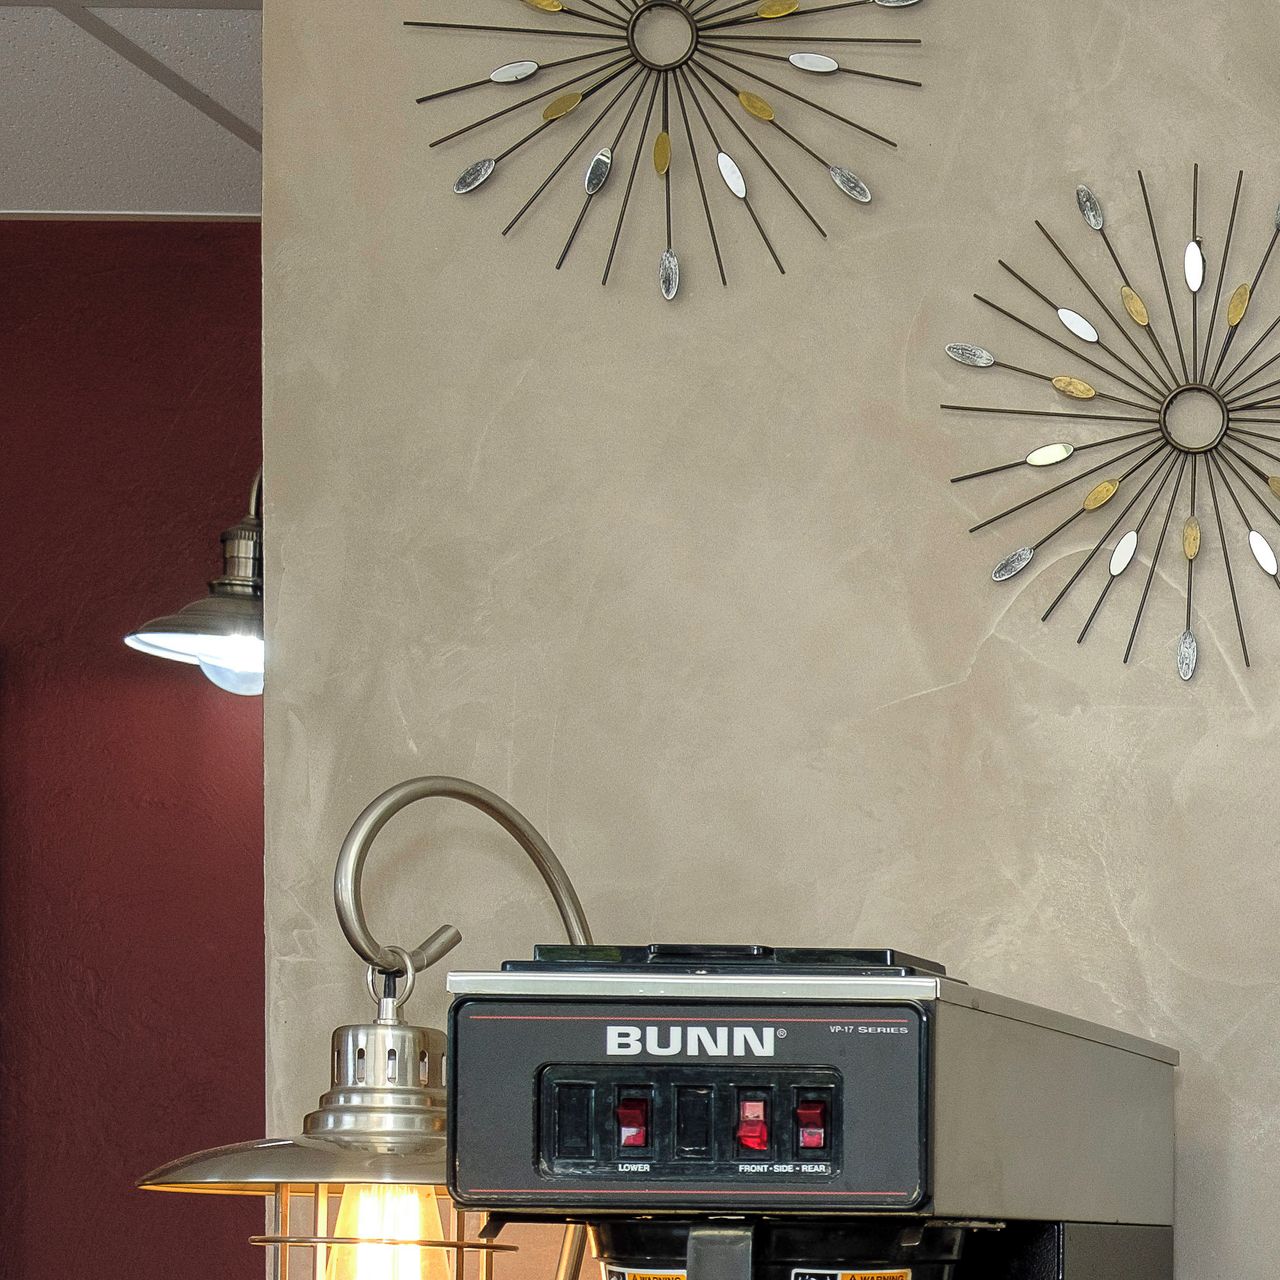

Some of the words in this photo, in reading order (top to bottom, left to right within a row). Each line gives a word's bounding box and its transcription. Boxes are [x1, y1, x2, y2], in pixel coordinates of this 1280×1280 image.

[830, 1025, 853, 1033] VP-17
[858, 1026, 908, 1034] SERIES
[606, 1025, 775, 1057] BUNN
[618, 1164, 650, 1172] LOWER
